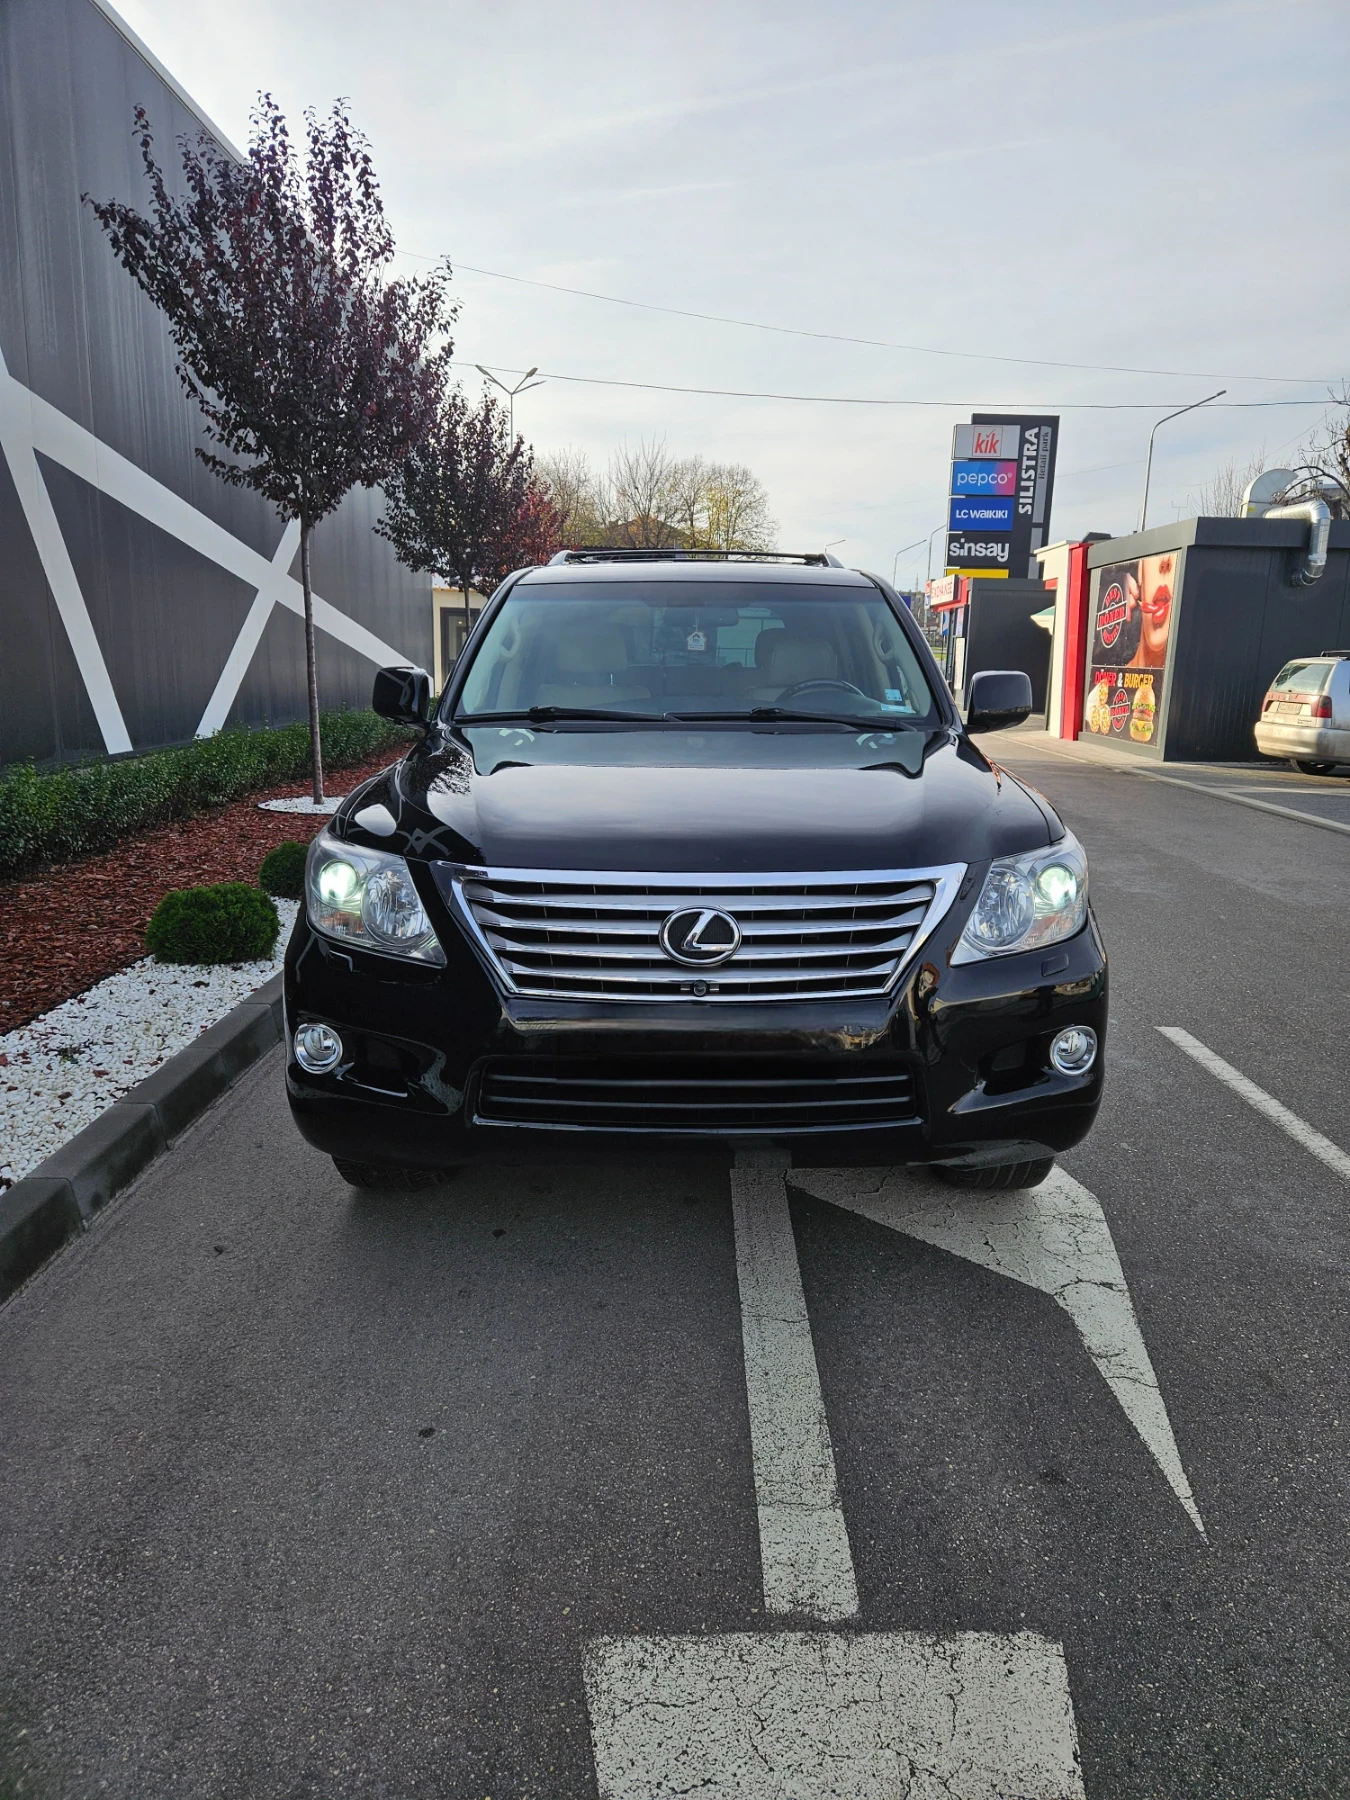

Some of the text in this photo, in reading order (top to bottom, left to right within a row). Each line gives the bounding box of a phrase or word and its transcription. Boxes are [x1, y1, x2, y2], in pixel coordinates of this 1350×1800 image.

[1039, 431, 1050, 480] Retail park
[1019, 427, 1039, 515] SILISTRA
[956, 509, 969, 519] LC
[949, 538, 1010, 562] sinsay
[1124, 673, 1154, 688] BURGER
